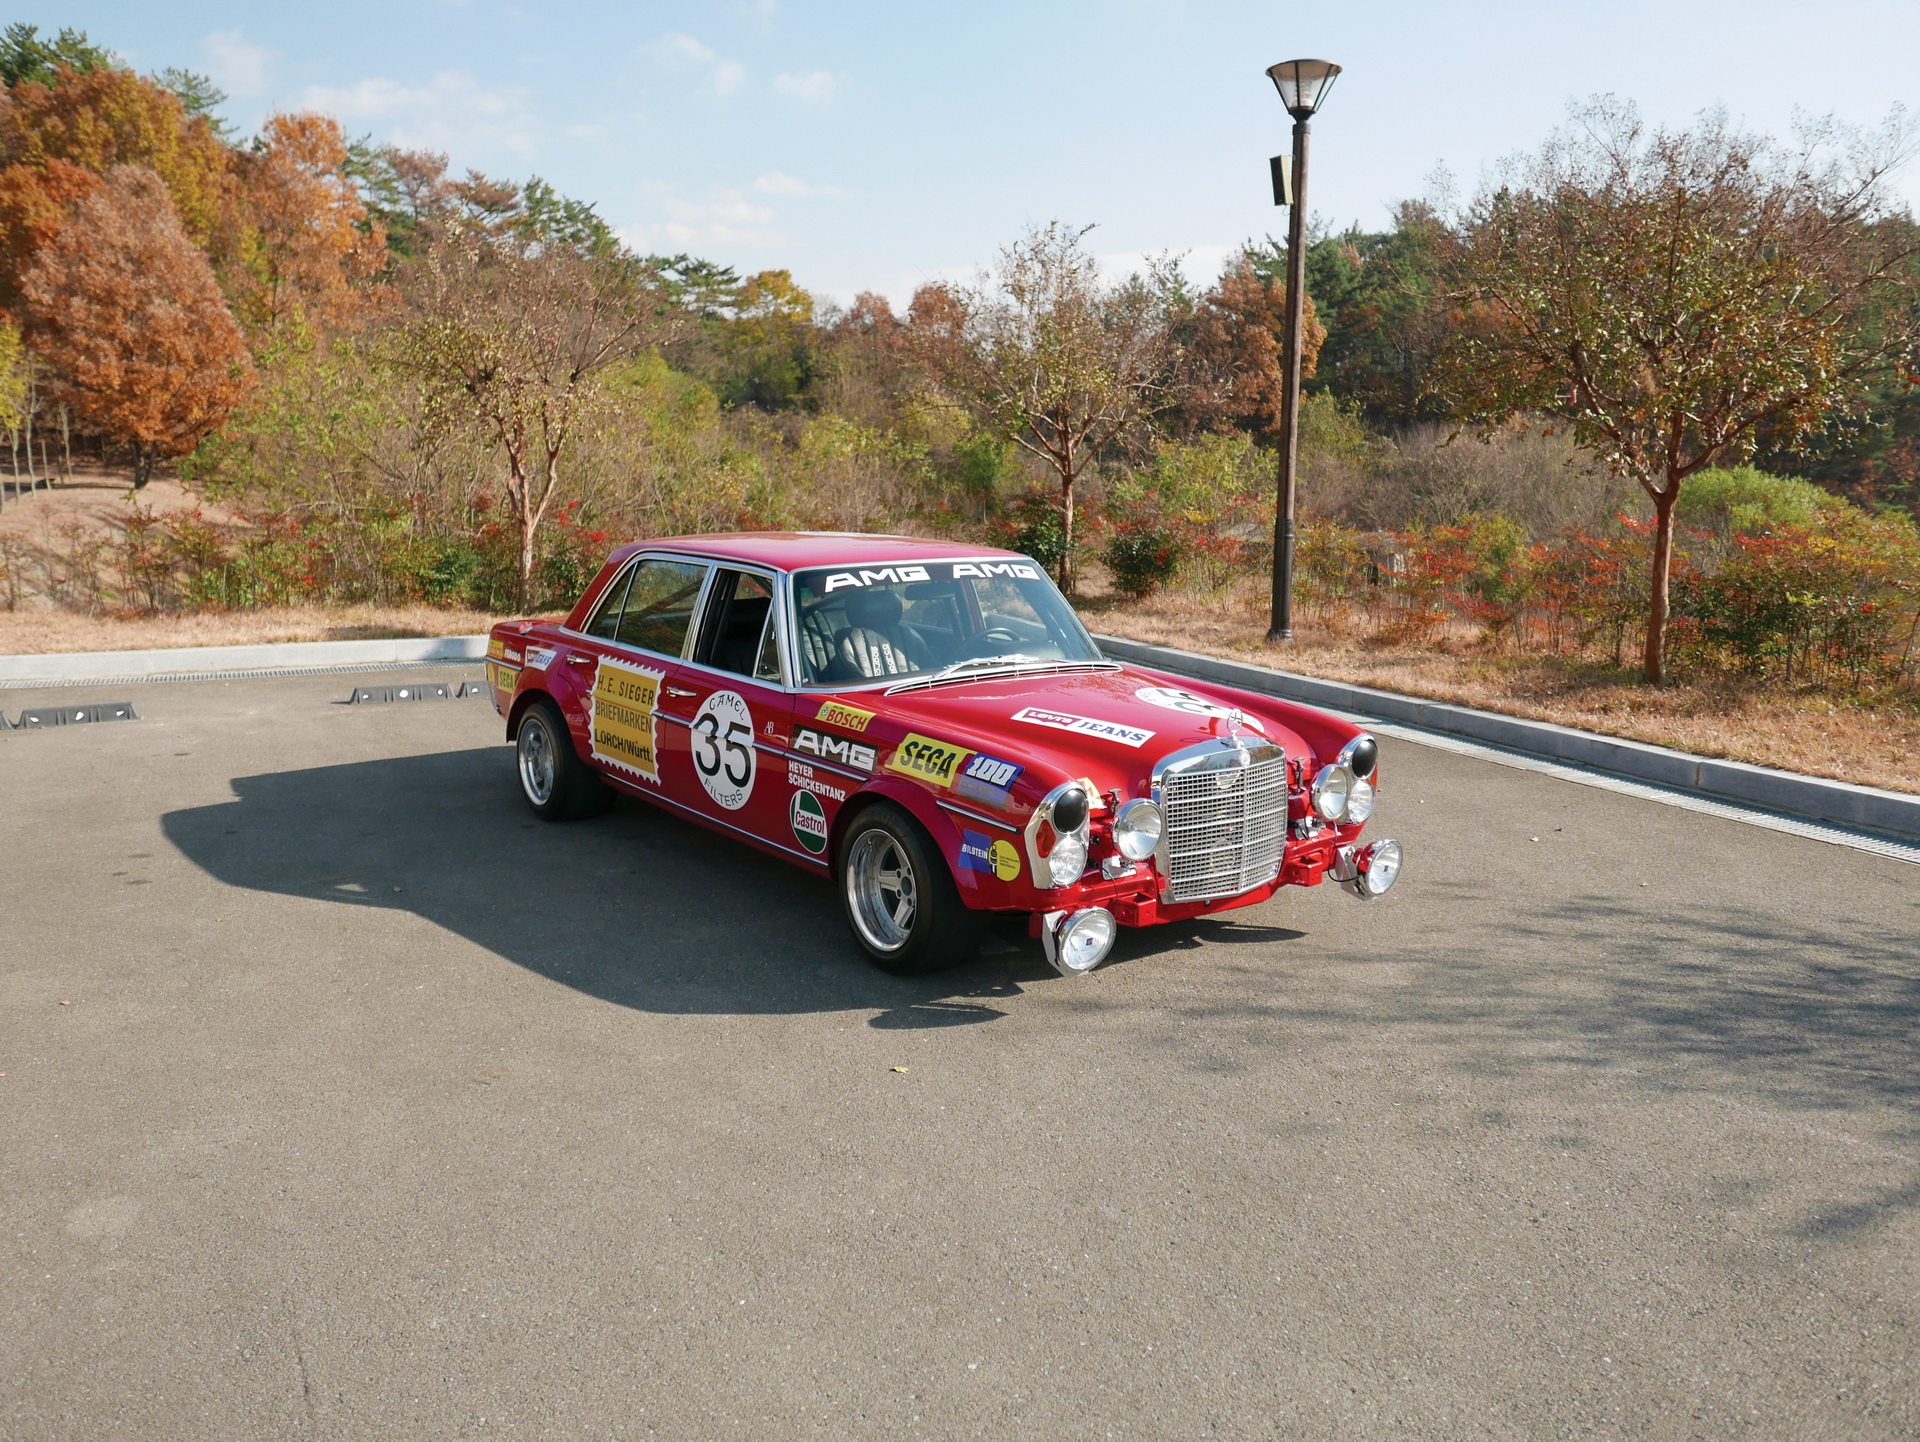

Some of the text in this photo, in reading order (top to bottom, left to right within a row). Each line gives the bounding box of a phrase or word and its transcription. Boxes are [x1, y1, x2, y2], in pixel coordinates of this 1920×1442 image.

[824, 563, 1040, 593] AMG AMG
[500, 670, 514, 689] SEGA
[597, 675, 655, 706] H.E. SIEGER
[595, 701, 652, 734] BRIEFMARKEN
[709, 694, 746, 720] CAMEL
[826, 709, 868, 730] BOSCH
[594, 728, 654, 763] LORCH/Württ.
[1077, 721, 1147, 741] JEANS
[693, 712, 751, 788] 35
[793, 729, 876, 771] AMG
[900, 741, 957, 779] SEGA
[788, 760, 813, 778] HEYER
[966, 756, 1017, 787] 100
[704, 778, 743, 807] FILTERS
[788, 772, 846, 802] SCHICKENTANZ
[795, 811, 825, 834] Castrol
[961, 843, 989, 860] BILSTEIN
